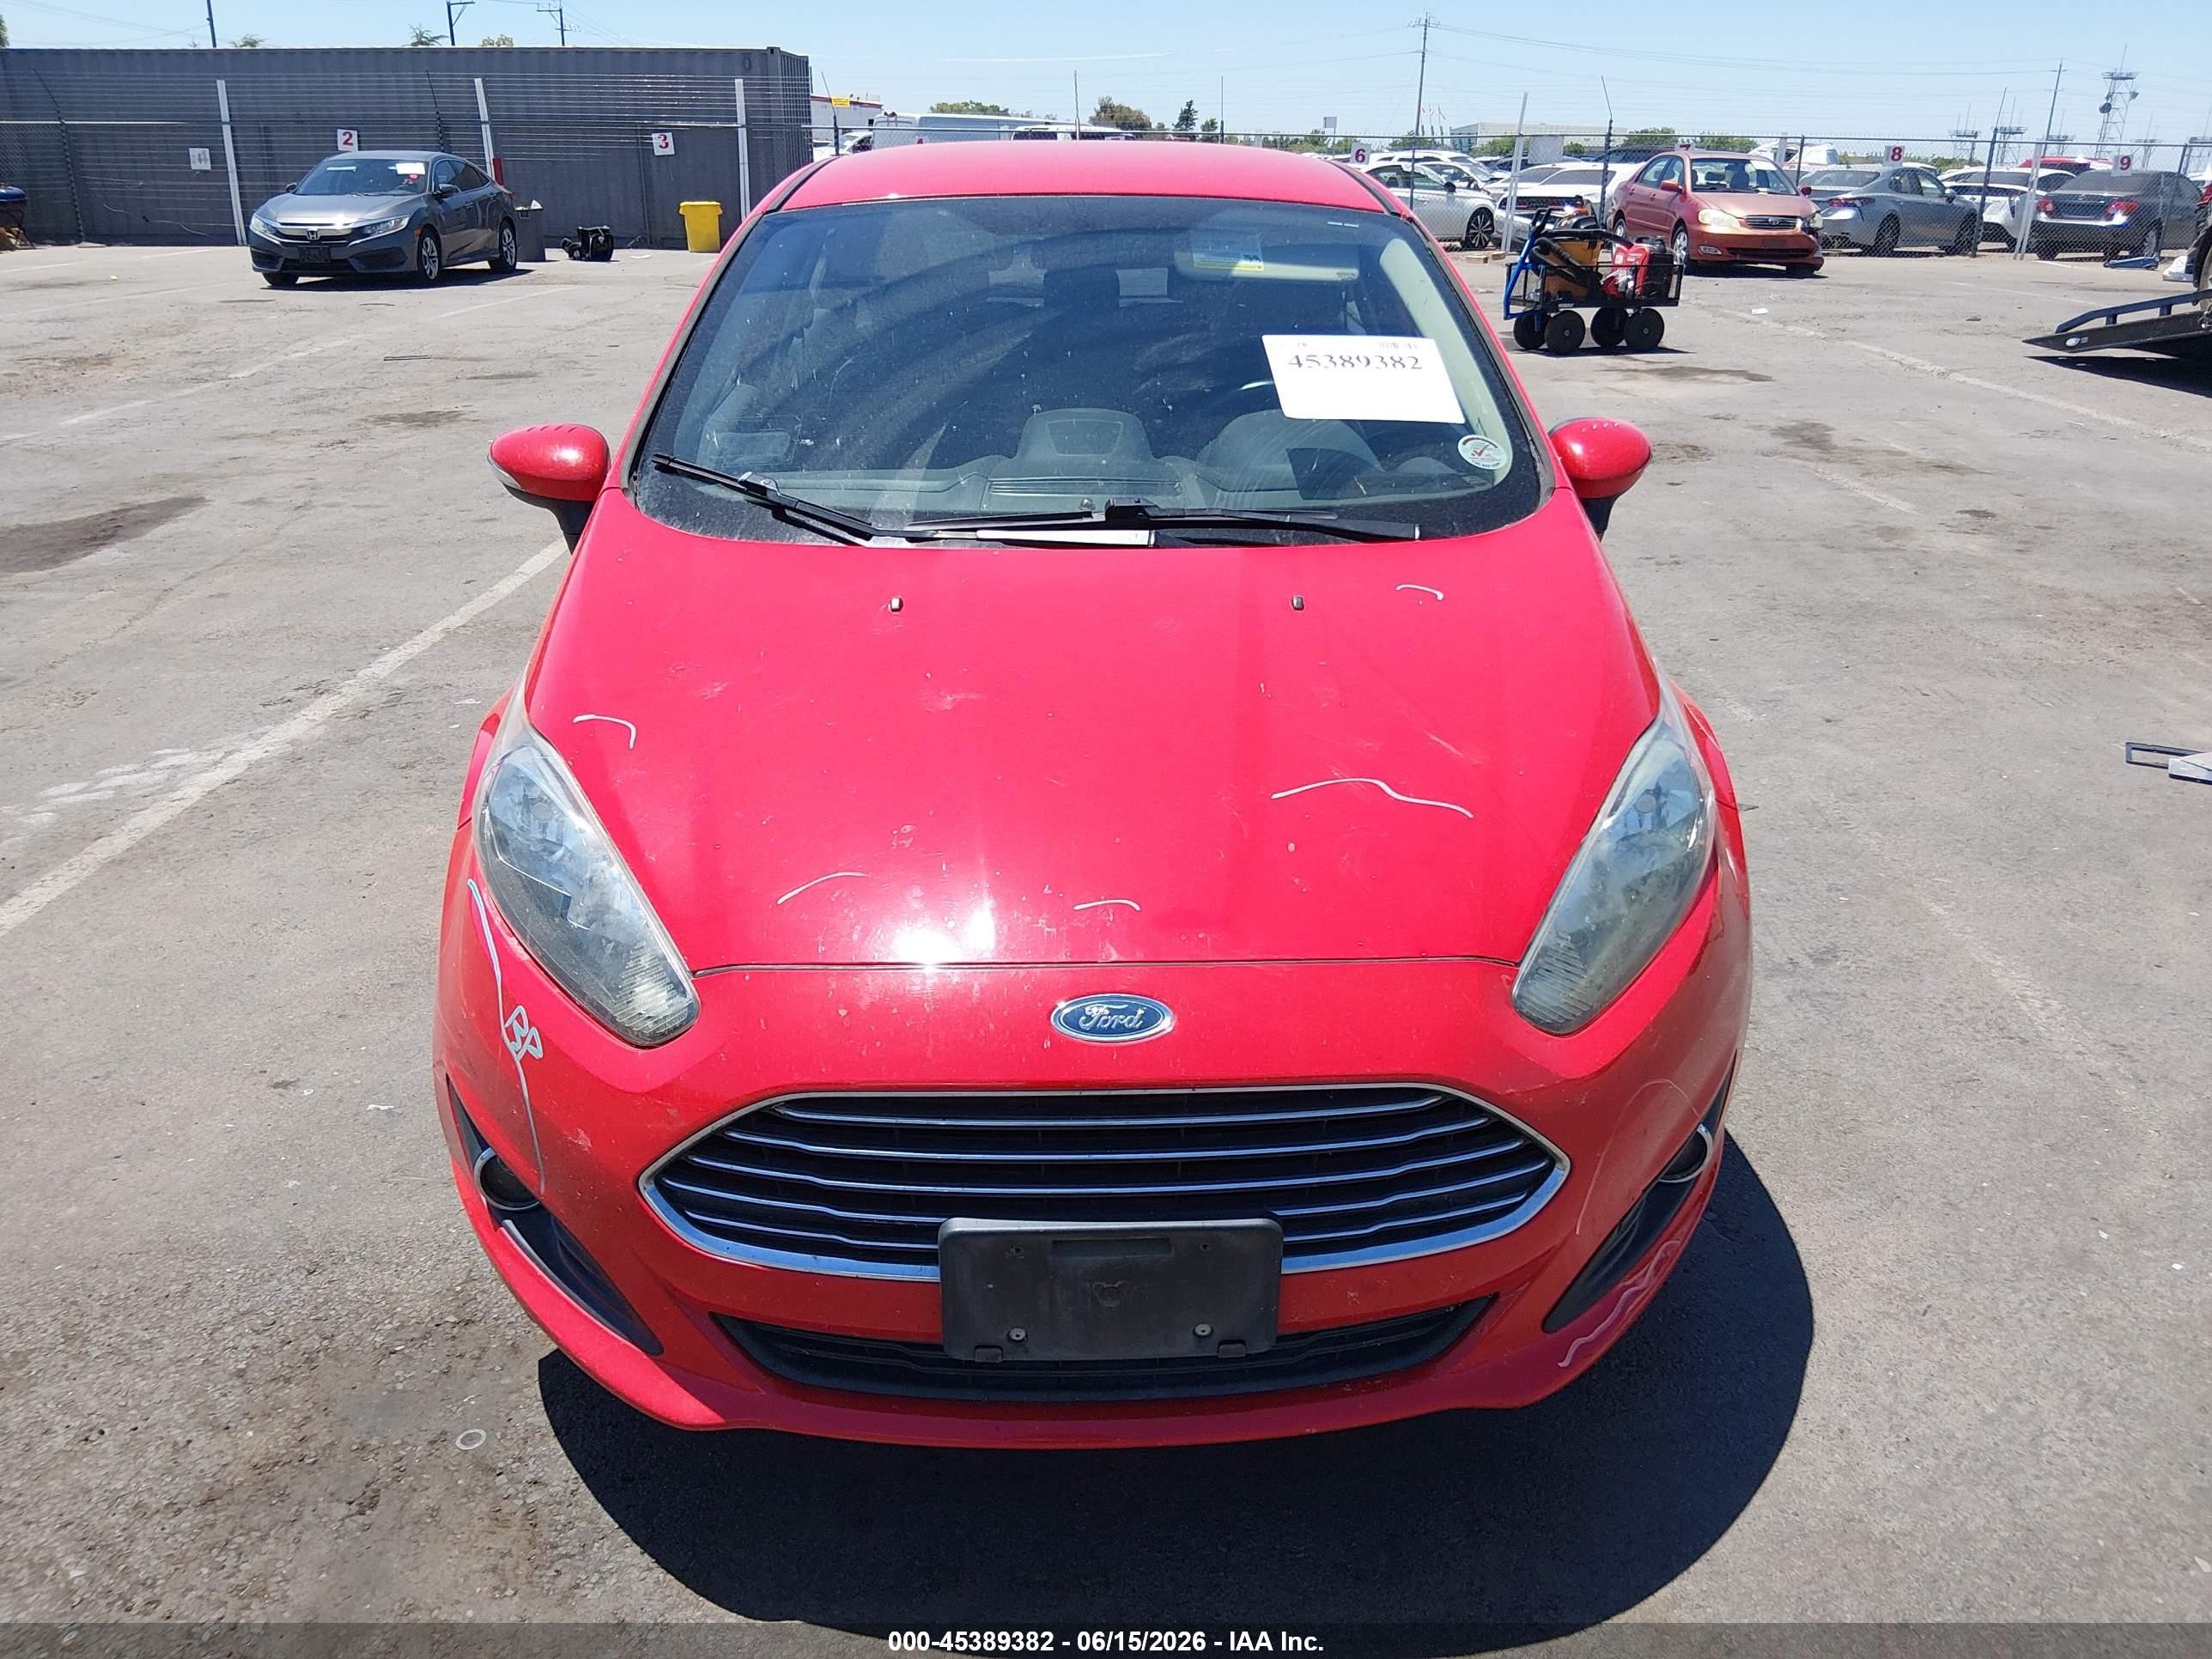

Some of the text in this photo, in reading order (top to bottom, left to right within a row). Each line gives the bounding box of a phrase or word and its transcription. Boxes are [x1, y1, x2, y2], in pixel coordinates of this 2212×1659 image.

[343, 131, 354, 146] 2
[658, 134, 670, 149] 3
[1354, 148, 1366, 163] 6
[1891, 146, 1903, 161] 8
[2119, 155, 2131, 171] 9
[1287, 354, 1423, 370] 45389382
[1078, 1003, 1147, 1030] Ford
